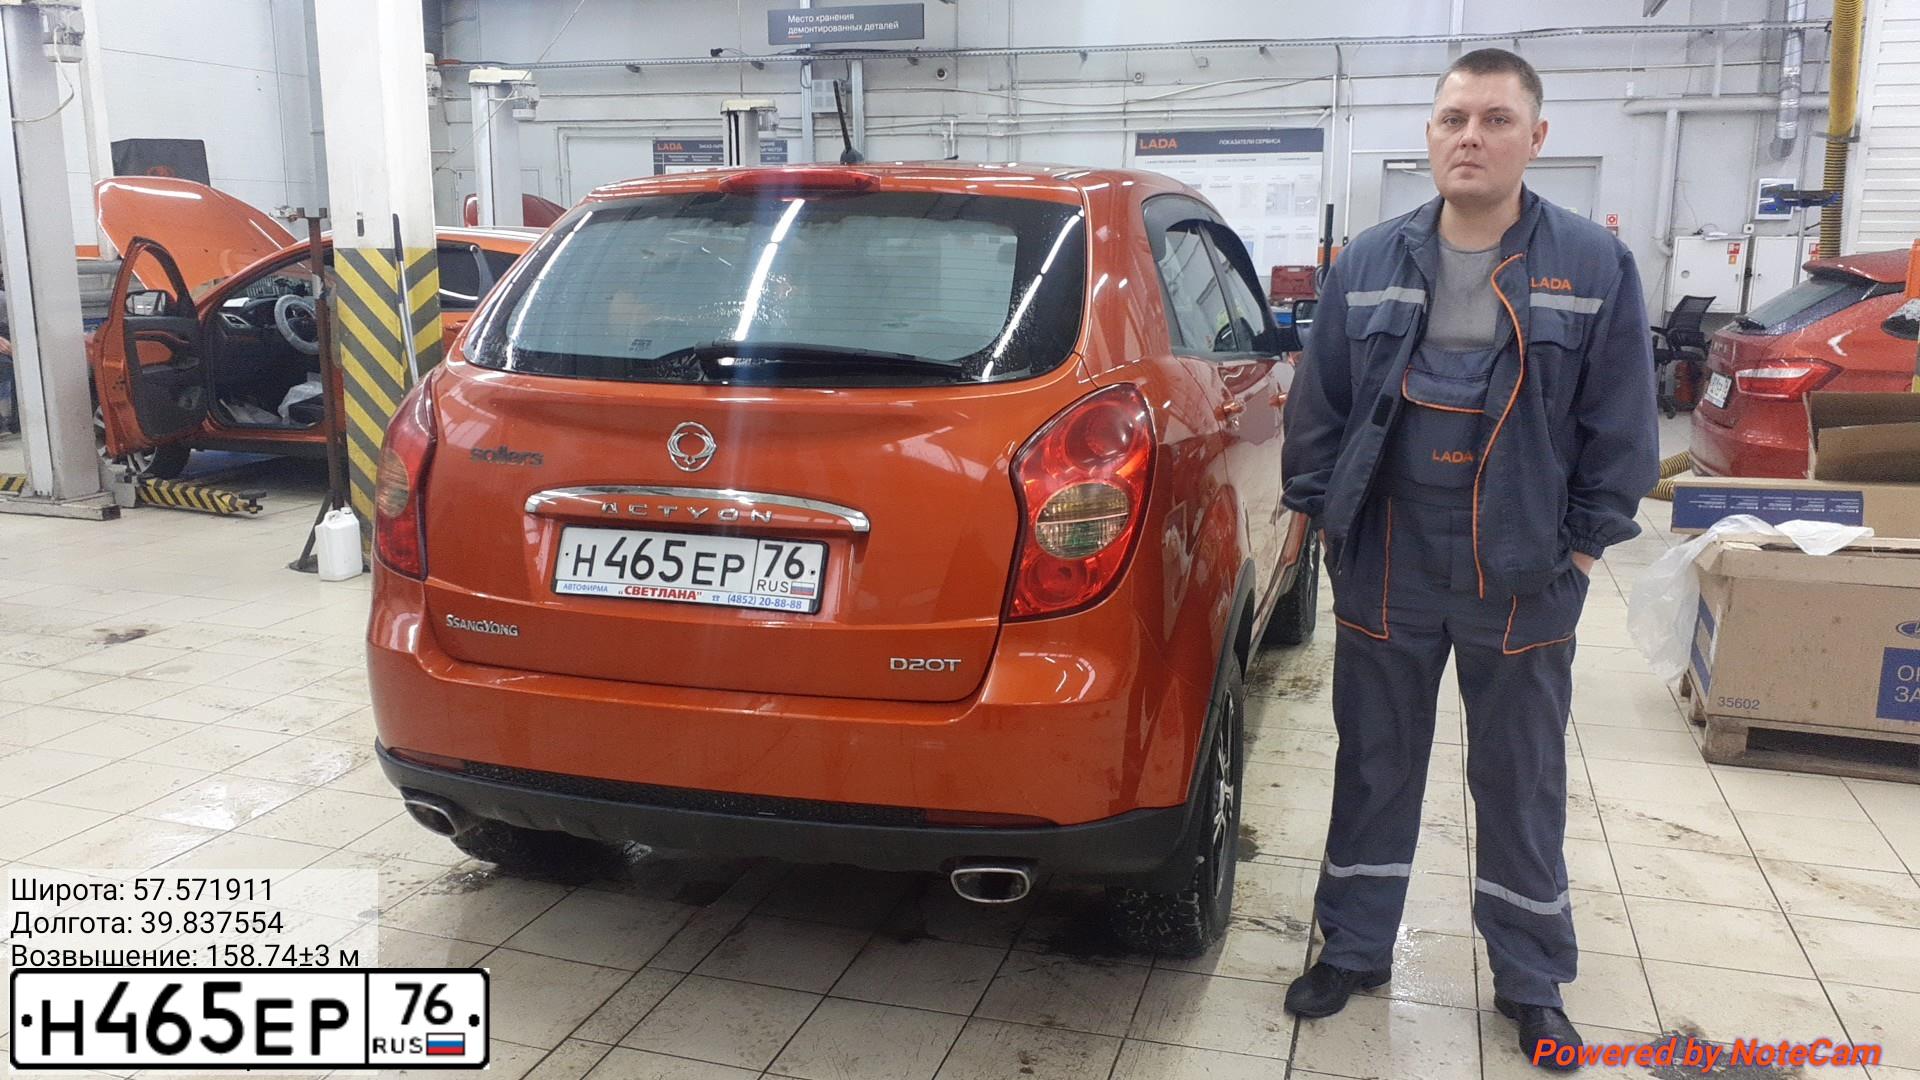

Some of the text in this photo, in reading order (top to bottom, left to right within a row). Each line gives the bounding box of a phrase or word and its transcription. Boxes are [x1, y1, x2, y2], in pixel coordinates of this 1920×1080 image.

[787, 13, 855, 24] Место хранения
[787, 20, 900, 36] демонтированных деталей
[656, 142, 684, 151] LADA
[1139, 137, 1179, 150] LADA
[1530, 277, 1573, 291] LADA
[1431, 448, 1474, 464] LADA
[601, 501, 773, 524] ACTYON
[762, 543, 805, 581] 76
[756, 578, 790, 594] RUS
[562, 581, 609, 594] АВТОФИРМА
[727, 593, 757, 606] (4852)
[758, 596, 803, 610] 20-88-88
[1716, 696, 1761, 711] 35602
